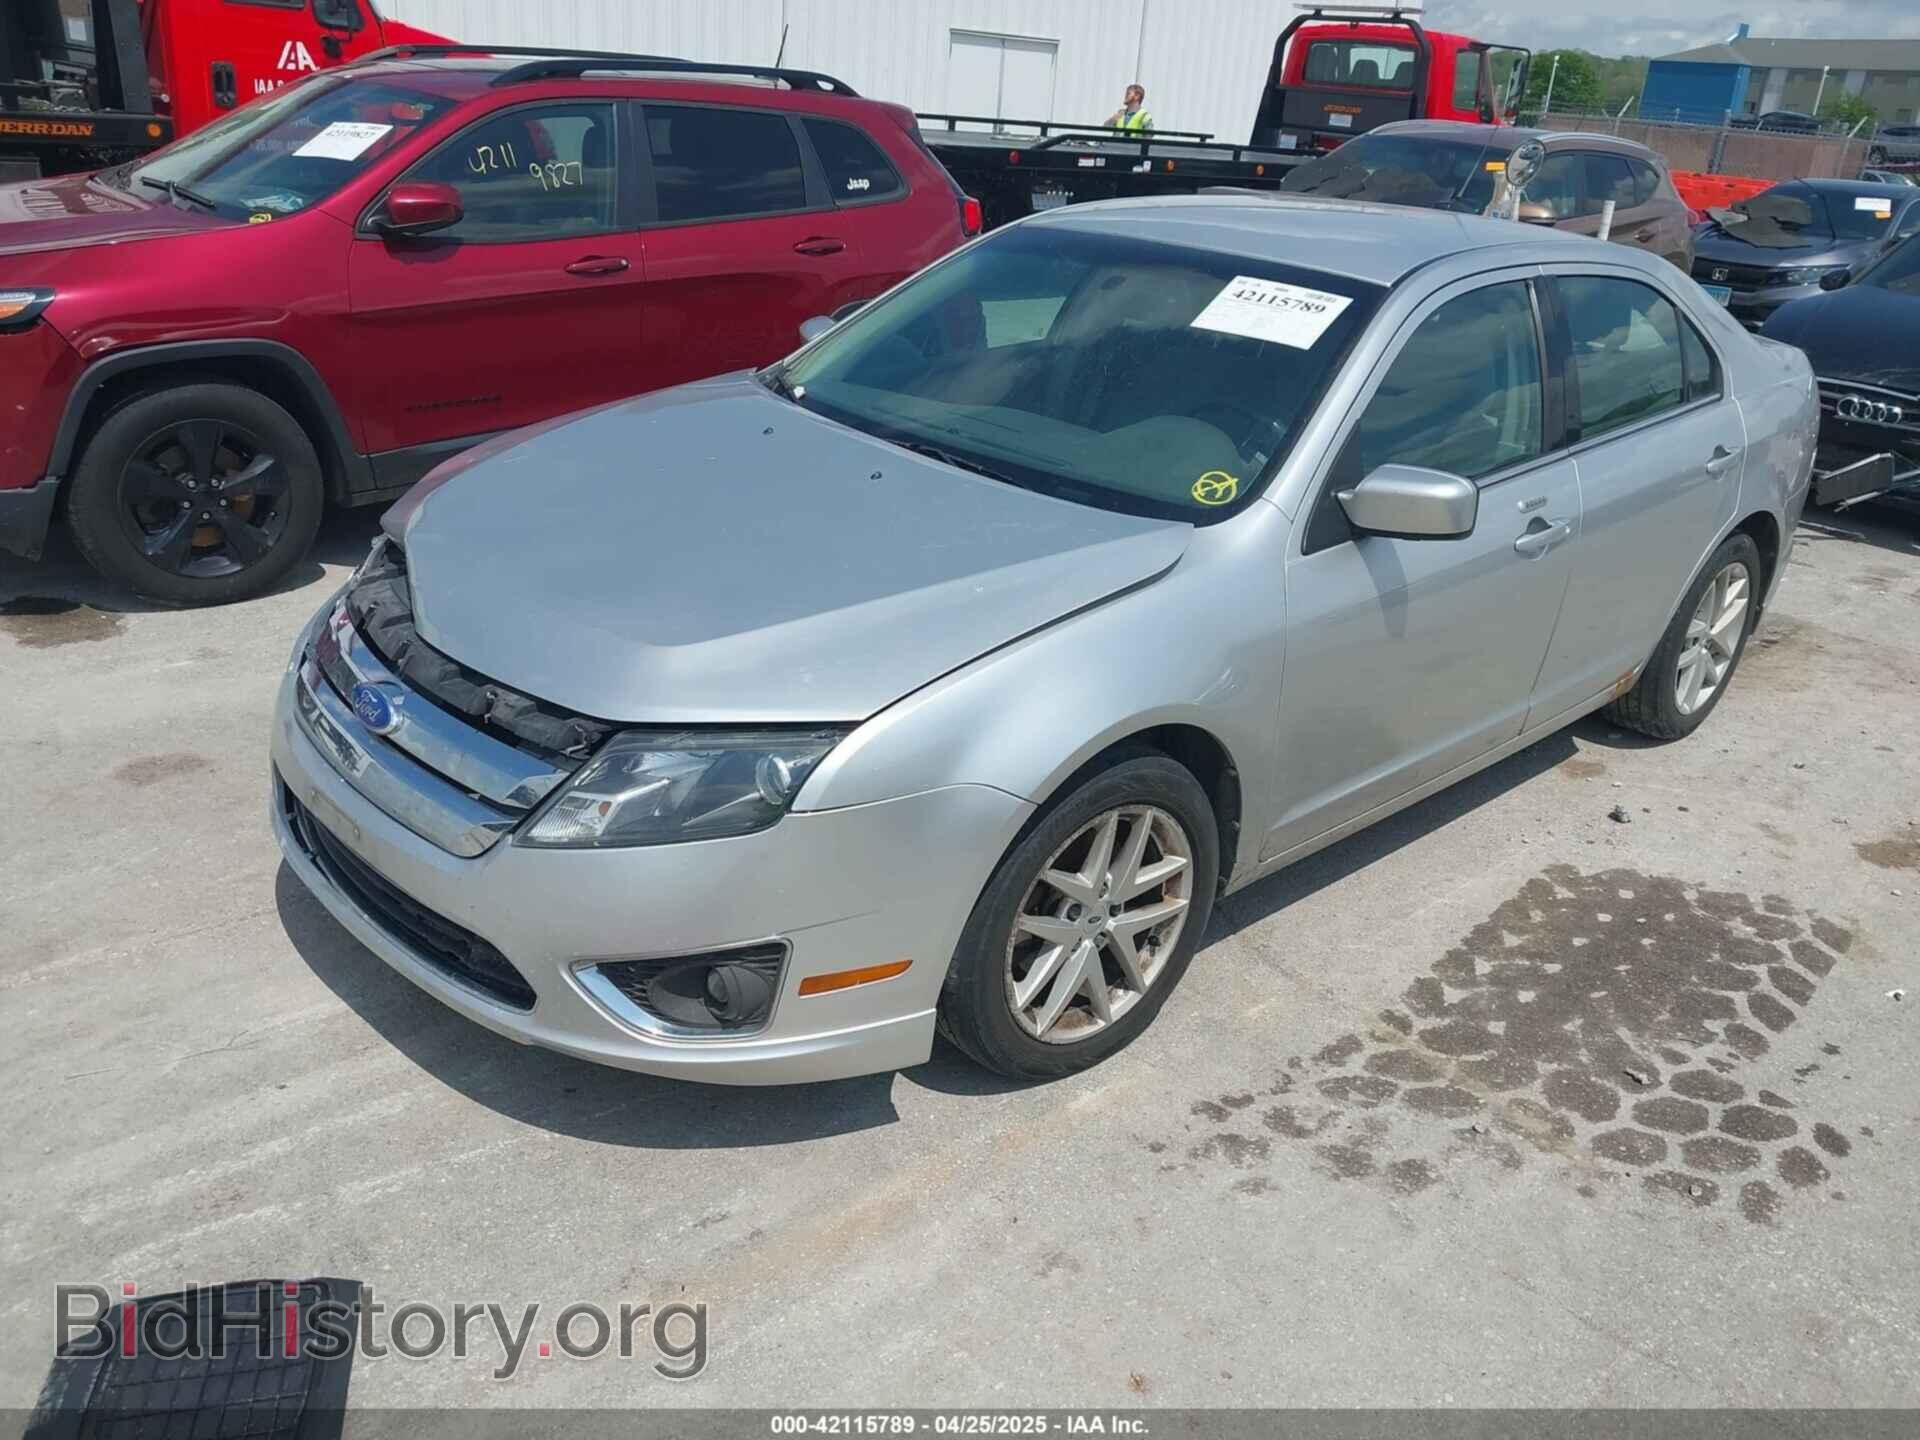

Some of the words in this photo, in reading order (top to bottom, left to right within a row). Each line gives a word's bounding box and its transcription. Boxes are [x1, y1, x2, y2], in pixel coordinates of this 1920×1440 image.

[468, 141, 518, 175] 4211
[529, 161, 583, 191] 9827
[1233, 289, 1326, 314] 42115789
[355, 689, 382, 723] Ford
